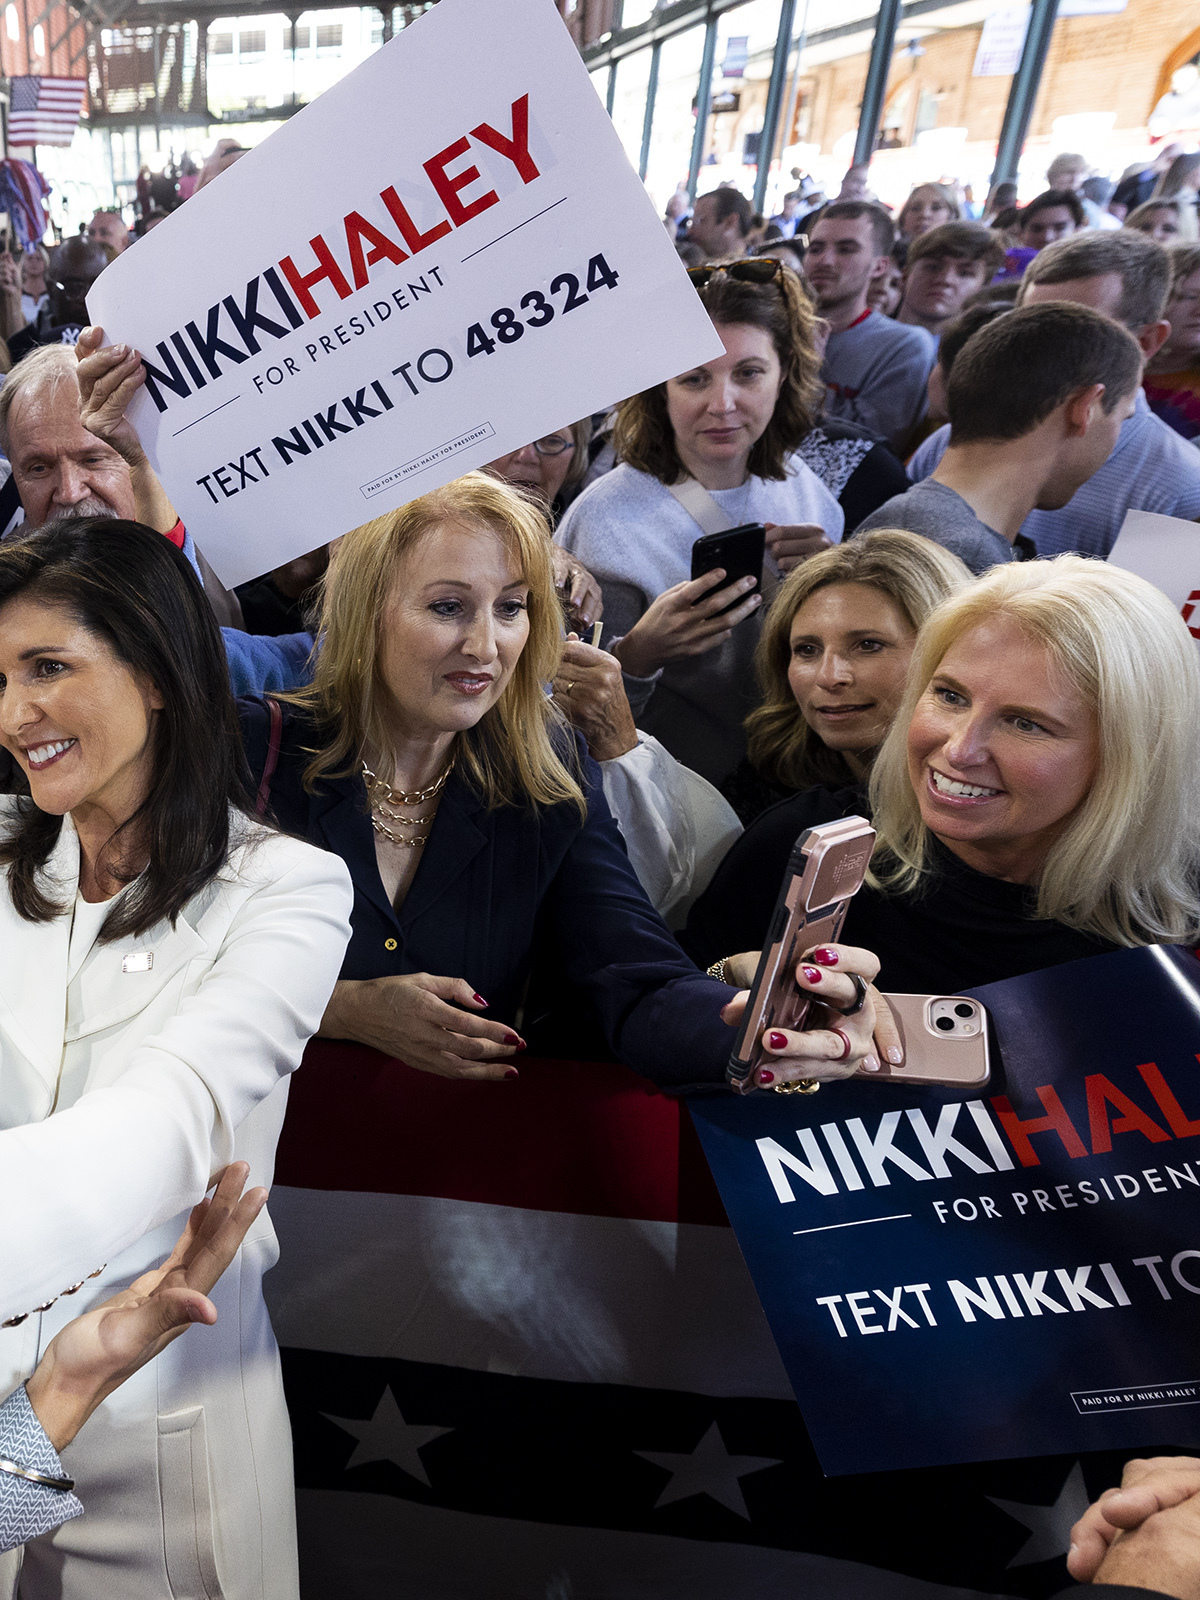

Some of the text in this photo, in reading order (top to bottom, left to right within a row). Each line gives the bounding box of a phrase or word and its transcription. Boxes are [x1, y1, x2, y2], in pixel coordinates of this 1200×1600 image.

[252, 266, 447, 395] FOR PRESIDENT
[196, 253, 620, 504] TEXT NIKKI TO 48324
[367, 428, 487, 493] PAID FOR BY NIKKI HALEY FOR PRESIDENT
[755, 1054, 1200, 1204] NIKKIHAL
[932, 1160, 1200, 1224] FOR PRESIDEN
[816, 1283, 938, 1338] TEXT
[947, 1263, 1132, 1323] NIKKI
[1081, 1387, 1197, 1406] PAID FOR BY NIKKI HALEY
